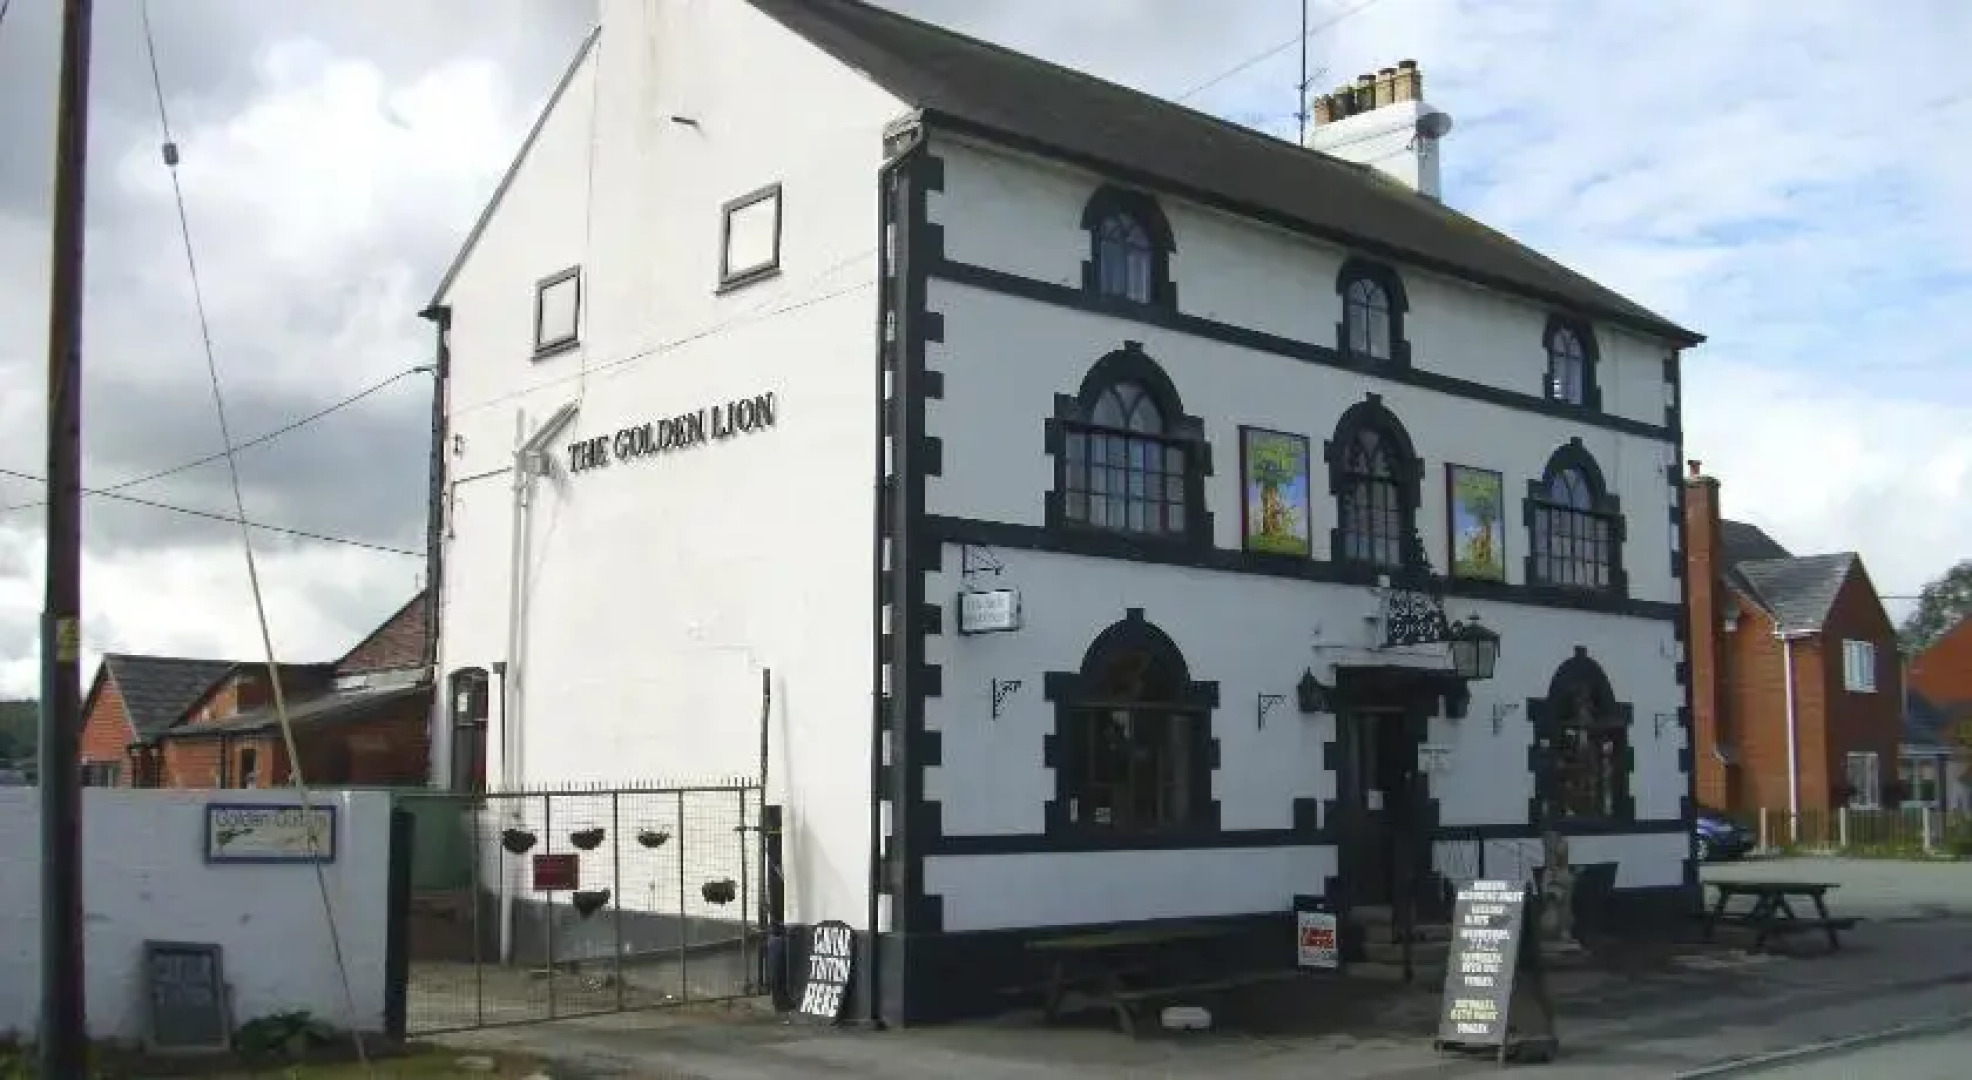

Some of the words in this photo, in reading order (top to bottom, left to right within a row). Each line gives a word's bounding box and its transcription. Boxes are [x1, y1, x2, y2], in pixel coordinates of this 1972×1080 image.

[567, 434, 609, 473] THE
[614, 407, 706, 461] GOLDEN
[711, 391, 774, 441] LION
[216, 811, 268, 827] Golden
